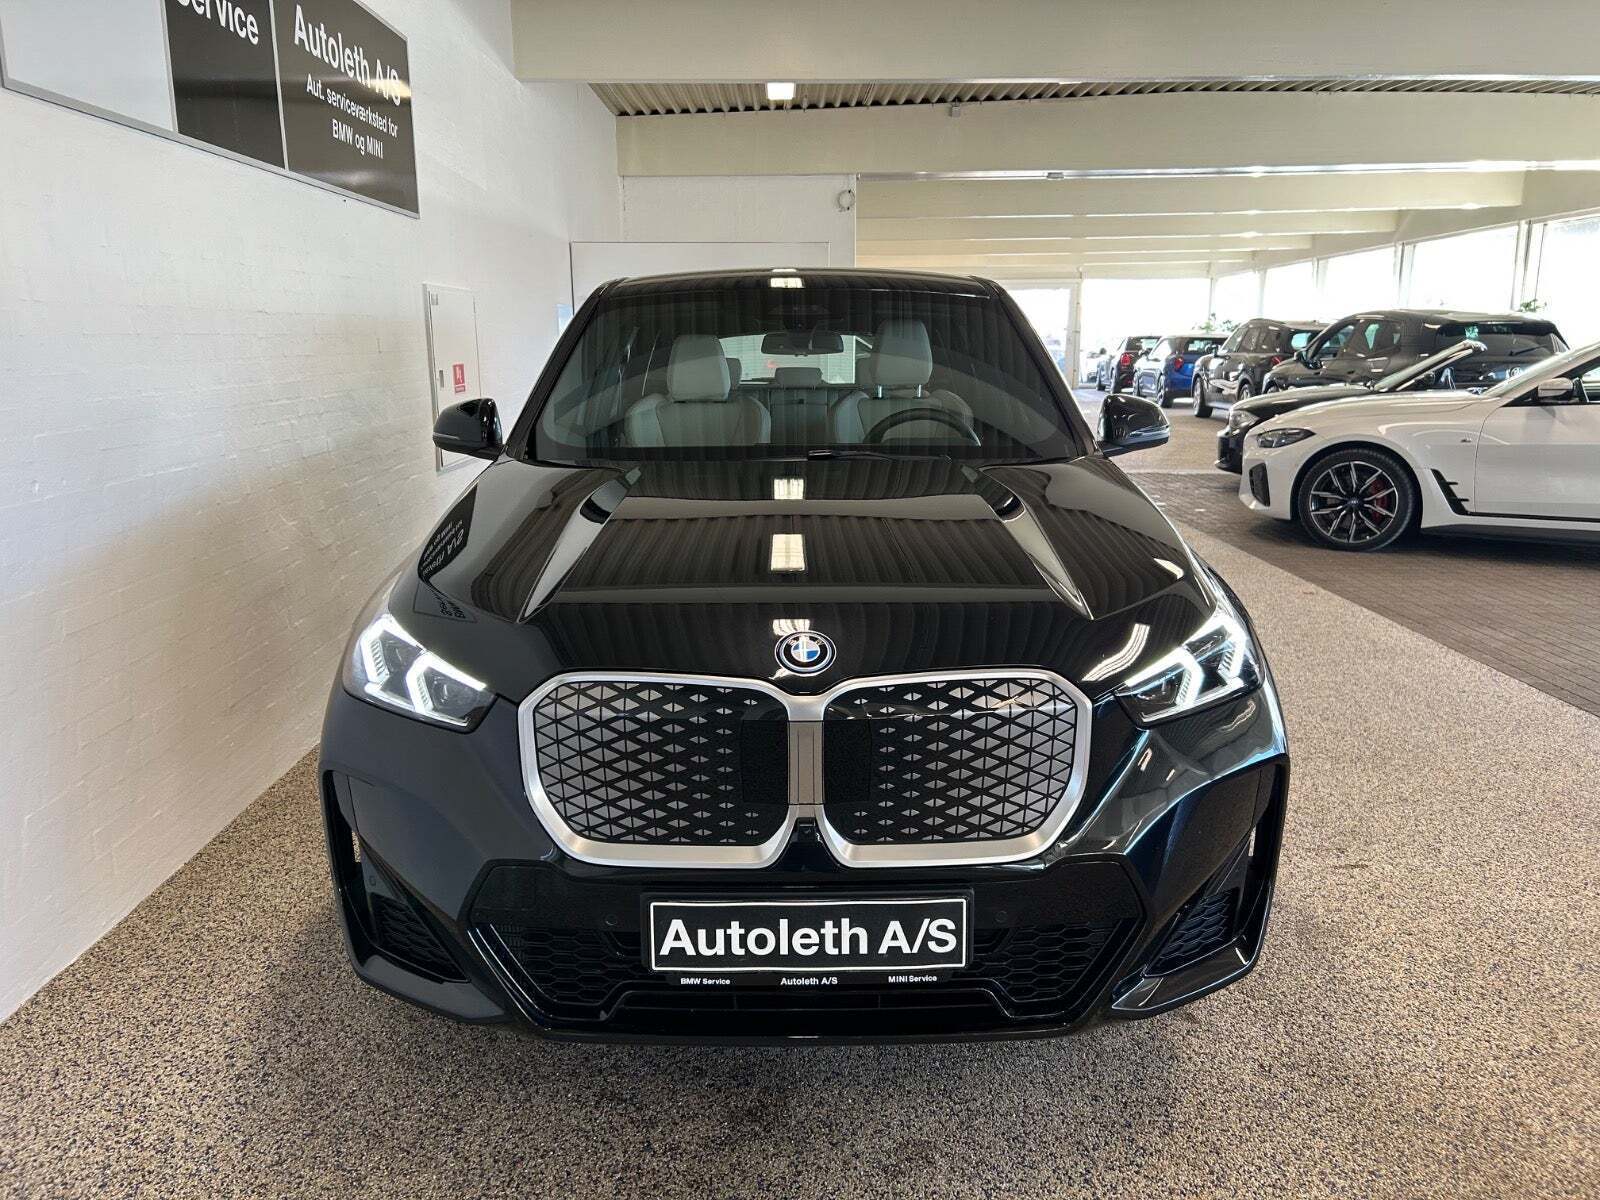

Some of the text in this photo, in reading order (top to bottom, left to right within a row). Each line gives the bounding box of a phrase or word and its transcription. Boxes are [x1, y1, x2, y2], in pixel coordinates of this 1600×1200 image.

[177, 0, 259, 45] ervice
[294, 4, 401, 106] Autoleth A/S
[306, 73, 398, 138] Aut. serviceværksted for
[332, 118, 384, 159] BMW og MINI
[659, 918, 957, 956] Autoleth A/S
[680, 977, 731, 985] BMW Service
[780, 976, 838, 985] Autoleth A/S
[888, 974, 938, 983] MINI Service
